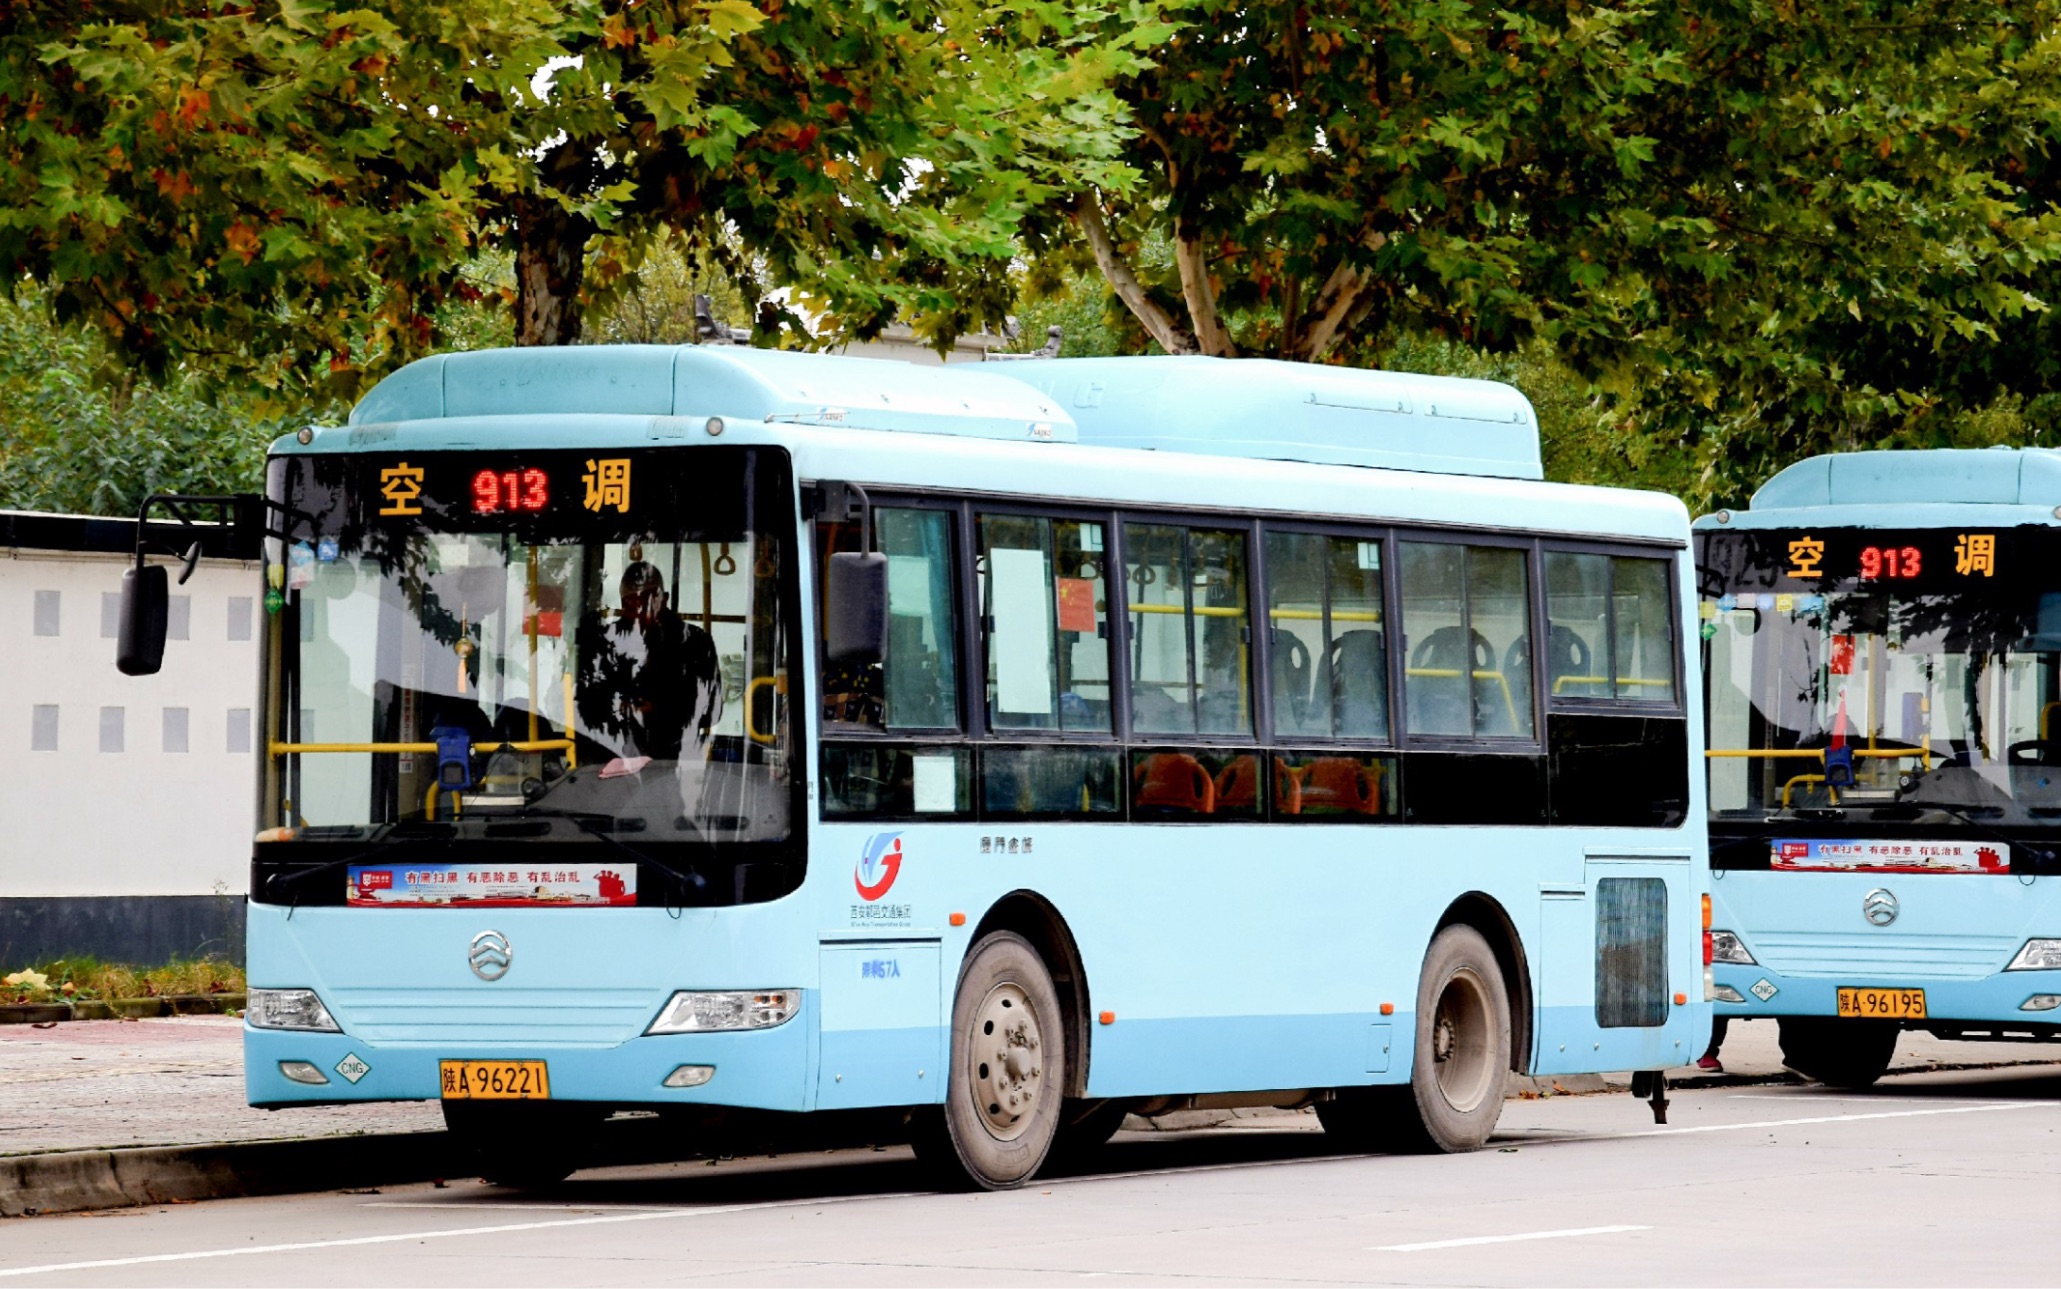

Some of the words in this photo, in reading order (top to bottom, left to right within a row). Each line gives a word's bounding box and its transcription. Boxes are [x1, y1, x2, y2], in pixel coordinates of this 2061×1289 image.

[379, 462, 424, 516] 空
[473, 468, 548, 512] 913
[581, 458, 631, 514] 调
[1786, 536, 1825, 578] 空
[1859, 546, 1923, 579] 913
[1953, 534, 1996, 578] 调
[405, 870, 459, 885] 有黑扫黑
[466, 870, 519, 884] 有恶除恶
[527, 870, 581, 884] 有乱治乱
[1755, 984, 1774, 996] CNG
[341, 1062, 364, 1074] CNG
